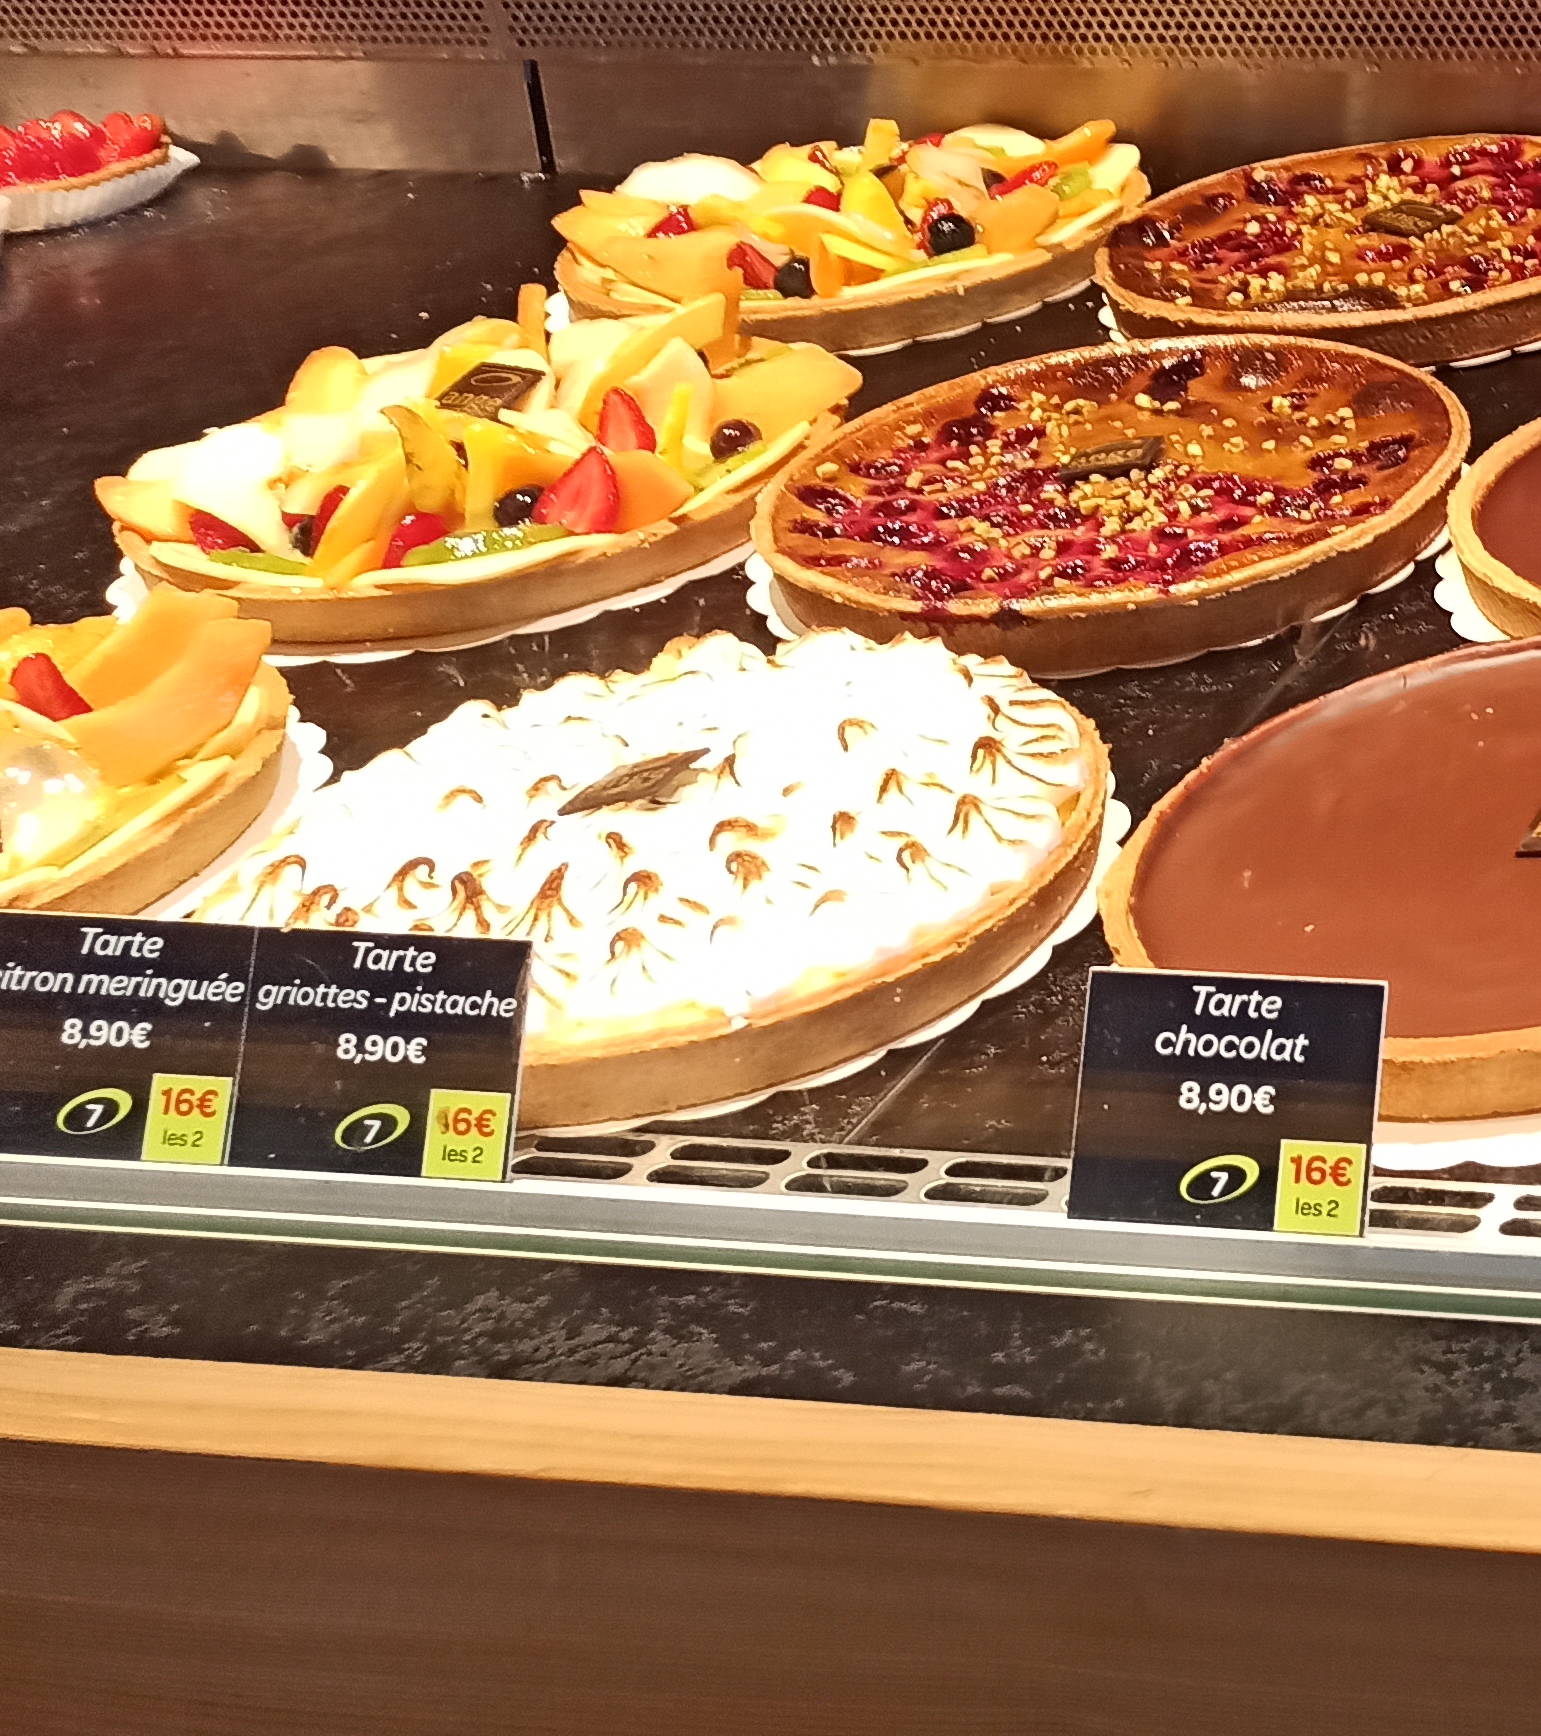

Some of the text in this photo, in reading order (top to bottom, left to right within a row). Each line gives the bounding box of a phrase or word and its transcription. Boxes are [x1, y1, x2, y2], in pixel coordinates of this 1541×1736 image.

[80, 927, 164, 958] Tarte
[352, 941, 436, 973] Tarte
[0, 961, 246, 1007] itron meringuée
[255, 979, 371, 1011] griottes
[389, 985, 518, 1018] pistache
[1192, 985, 1283, 1020] Tarte
[60, 1017, 153, 1050] 8,90€
[336, 1033, 429, 1065] 8,90€
[1154, 1024, 1309, 1063] chocolat
[161, 1087, 219, 1118] 16€
[1178, 1081, 1276, 1115] 8,90€
[85, 1103, 105, 1128] 7
[363, 1119, 382, 1144] 7
[160, 1128, 204, 1148] les 2
[441, 1144, 485, 1164] les 2
[1209, 1171, 1230, 1198] 7
[1290, 1154, 1354, 1187] 16€
[1294, 1197, 1340, 1218] les 2
